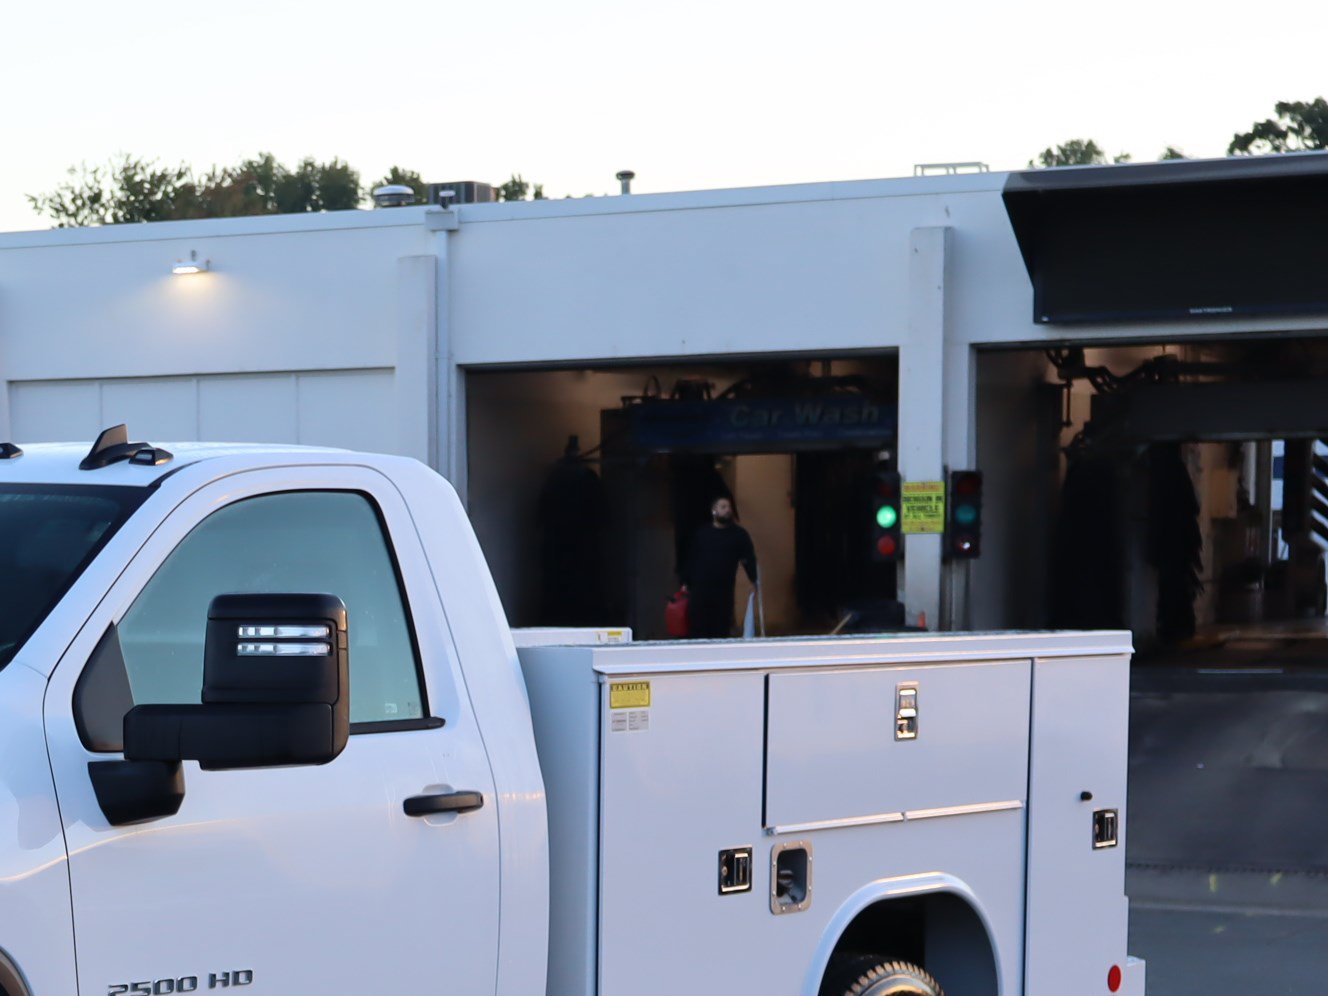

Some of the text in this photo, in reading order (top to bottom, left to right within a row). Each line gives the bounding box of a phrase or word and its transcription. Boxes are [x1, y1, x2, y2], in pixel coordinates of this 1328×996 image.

[730, 400, 879, 428] Car Wash
[612, 683, 648, 691] CAUTION
[208, 970, 253, 989] HD
